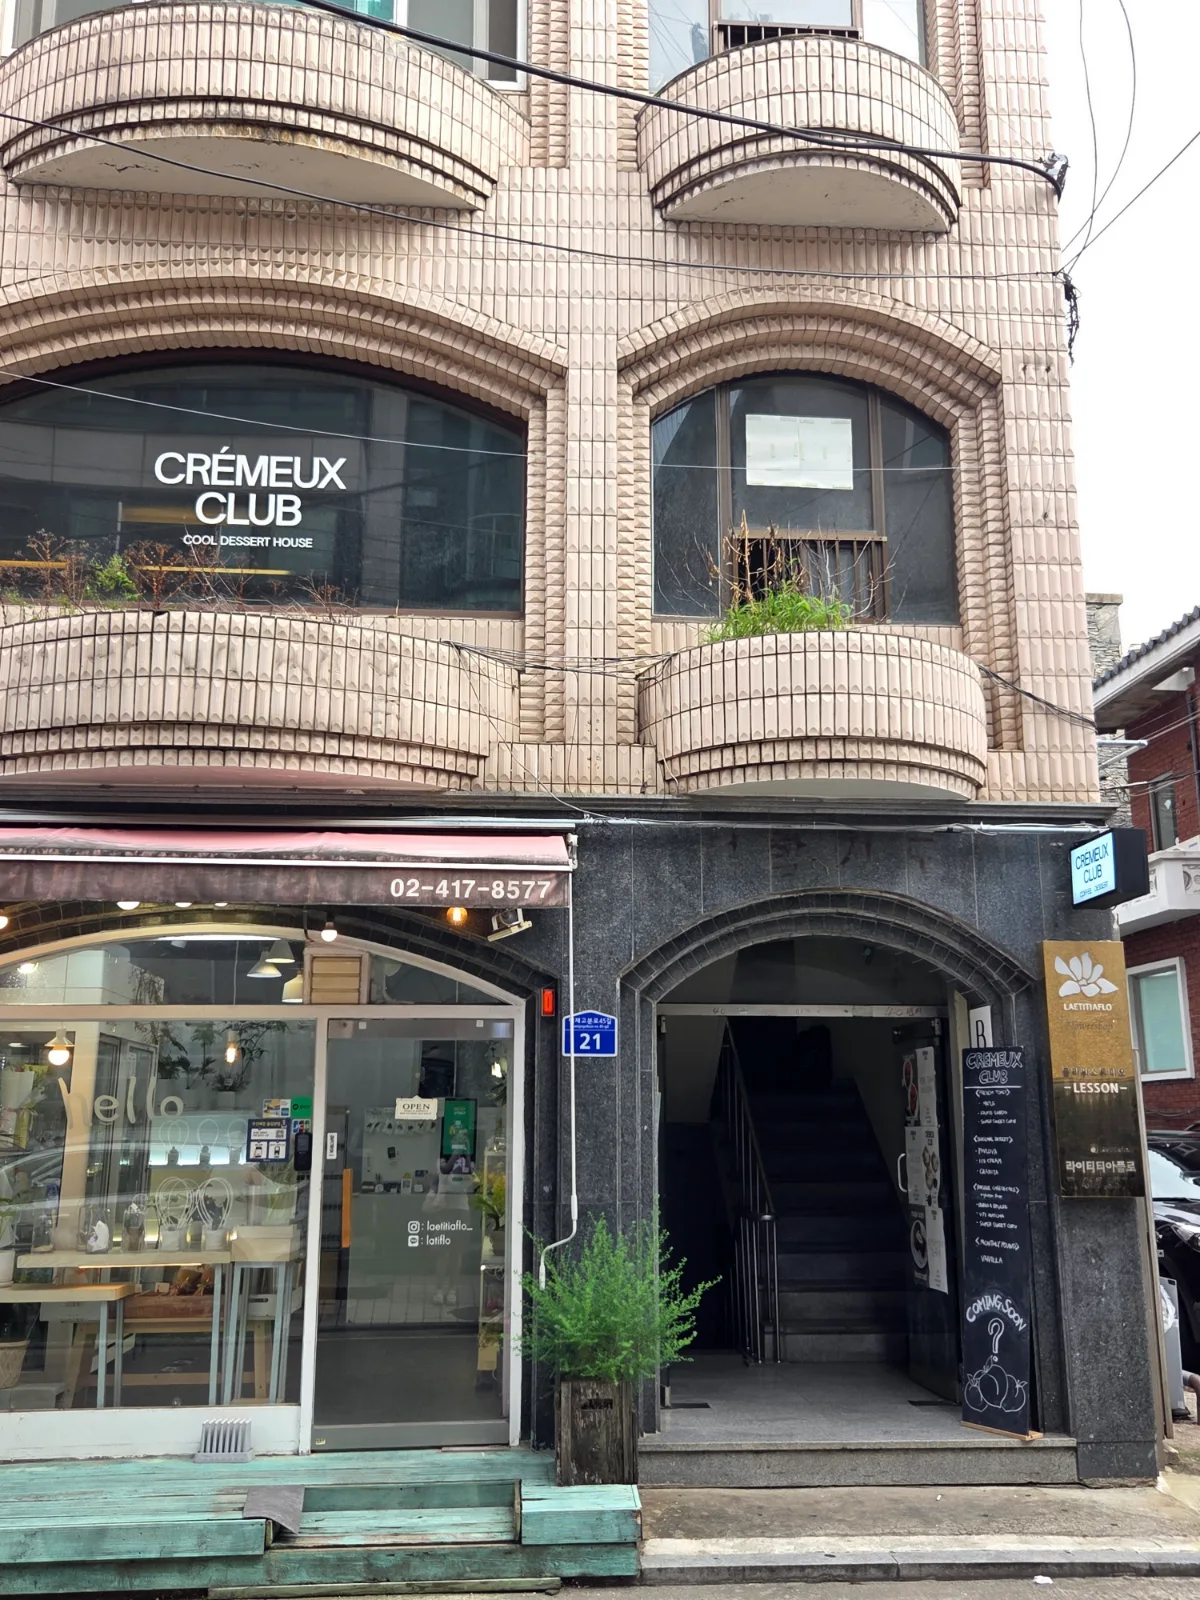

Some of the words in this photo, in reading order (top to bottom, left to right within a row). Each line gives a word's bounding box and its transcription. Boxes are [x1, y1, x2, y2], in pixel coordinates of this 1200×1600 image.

[154, 446, 347, 490] CRÉMEUX
[195, 491, 302, 527] CLUB
[183, 534, 217, 546] COOL
[220, 535, 272, 547] DESSERT
[273, 537, 313, 548] HOUSE
[1083, 863, 1103, 884] CLUB
[390, 878, 551, 899] 02-417-8577
[1063, 1003, 1113, 1011] LAETITIAFLO
[569, 1016, 612, 1026] 제고분로45길
[579, 1032, 601, 1050] 21
[979, 1069, 1009, 1084] CLUB
[1065, 1160, 1137, 1174] 라이티티아플로
[426, 1234, 451, 1245] latiflo
[980, 1255, 1003, 1264] VANILLA
[966, 1294, 1002, 1322] COMING
[1001, 1299, 1027, 1331] SOON
